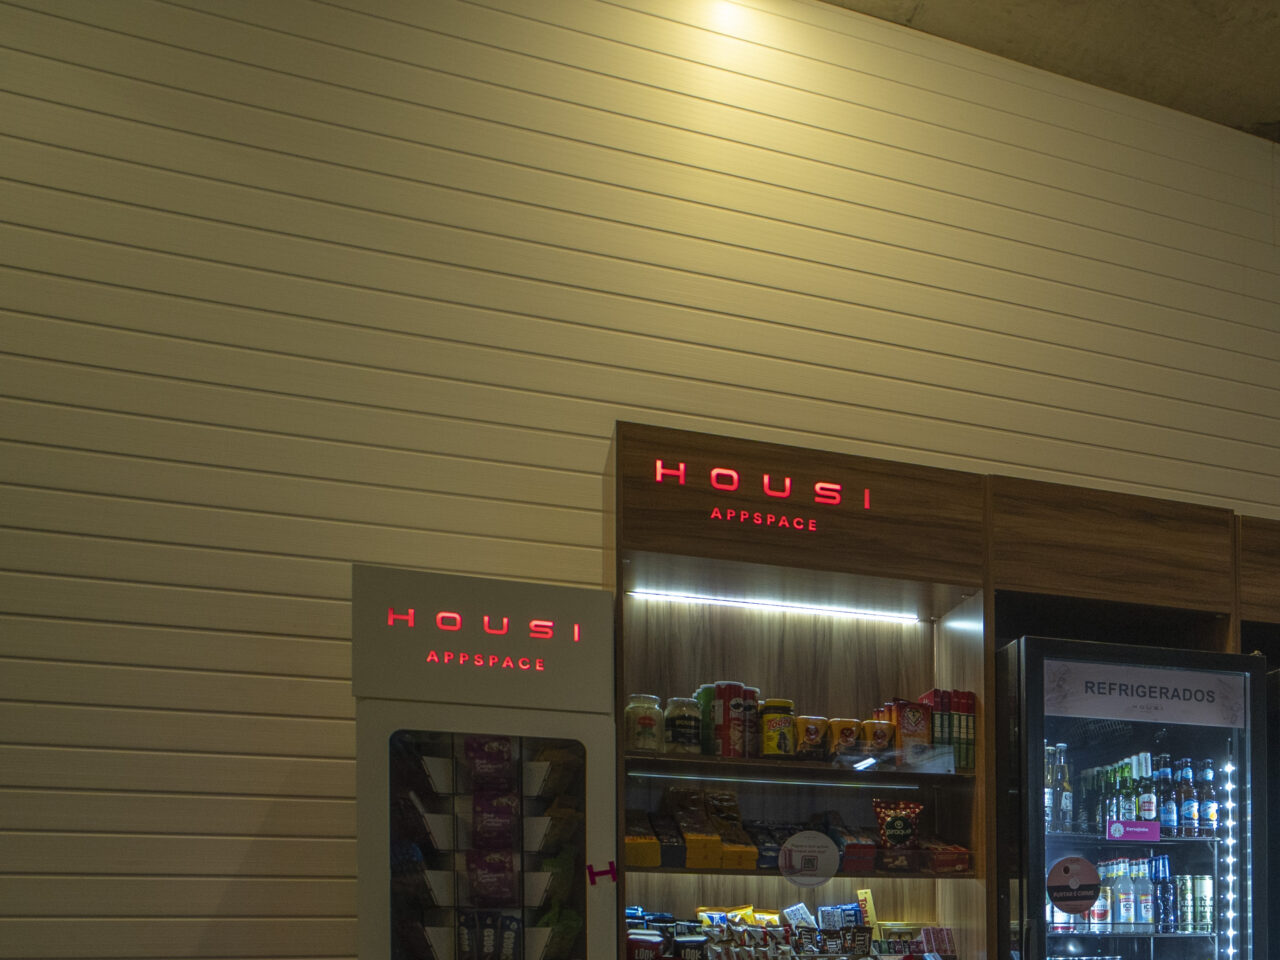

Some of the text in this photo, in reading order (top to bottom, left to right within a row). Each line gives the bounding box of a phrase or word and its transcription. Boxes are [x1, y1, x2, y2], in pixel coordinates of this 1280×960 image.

[655, 459, 870, 510] HOUSI
[710, 507, 819, 531] APPSPACE
[388, 608, 581, 642] HOUSI
[426, 650, 546, 671] APPSPACE
[1084, 680, 1217, 704] REFRIGERADOS
